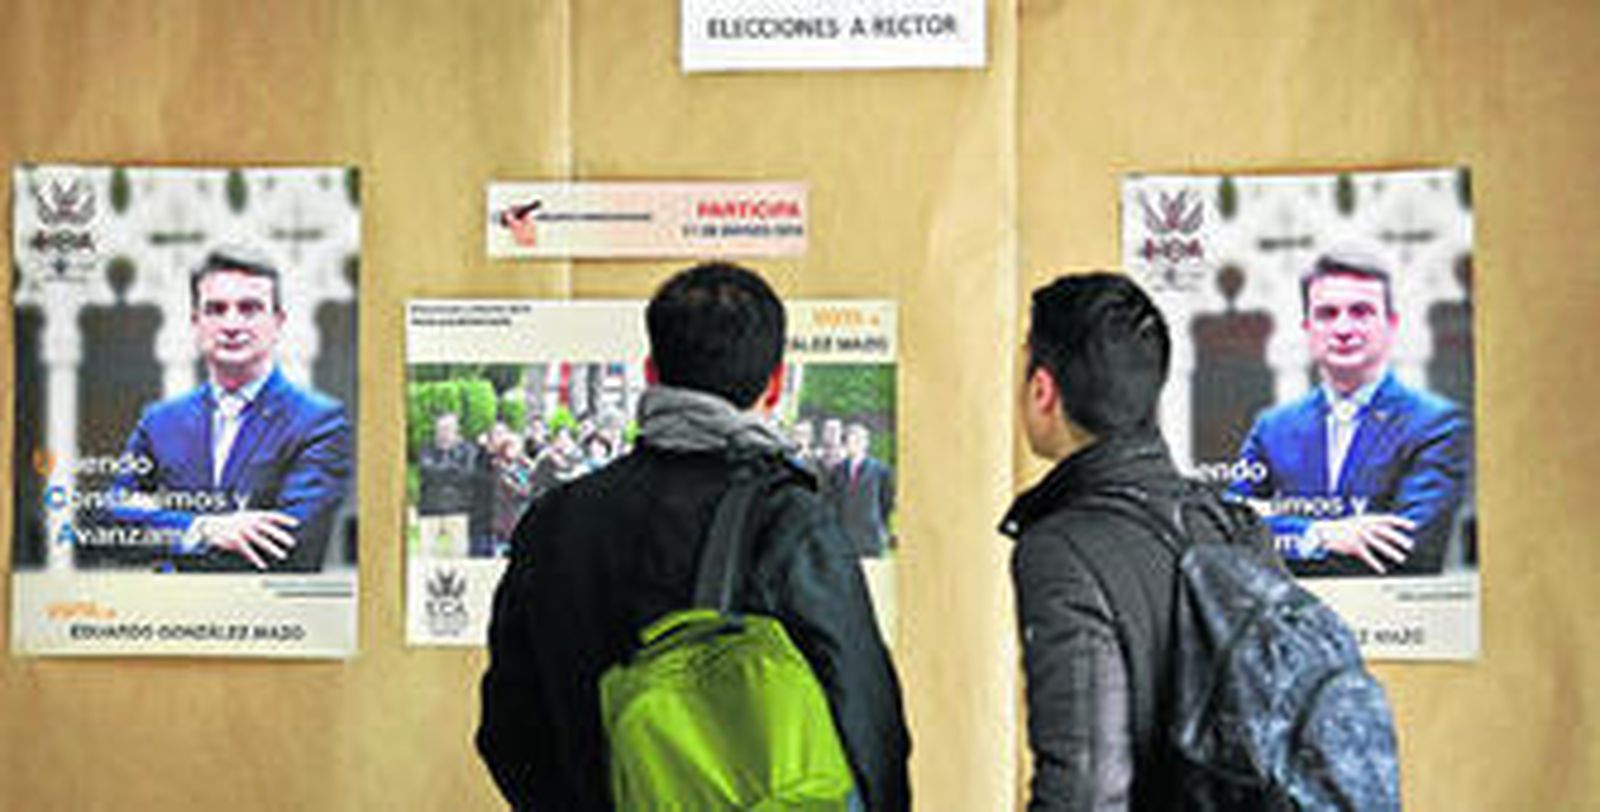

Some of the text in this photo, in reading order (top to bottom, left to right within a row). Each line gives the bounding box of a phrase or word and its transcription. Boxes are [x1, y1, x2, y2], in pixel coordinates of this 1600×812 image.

[706, 13, 958, 39] ELECCIONES A RECTOR
[697, 199, 801, 218] PARTICIPA
[70, 623, 153, 641] EDUARDO
[253, 624, 306, 641] MAZO
